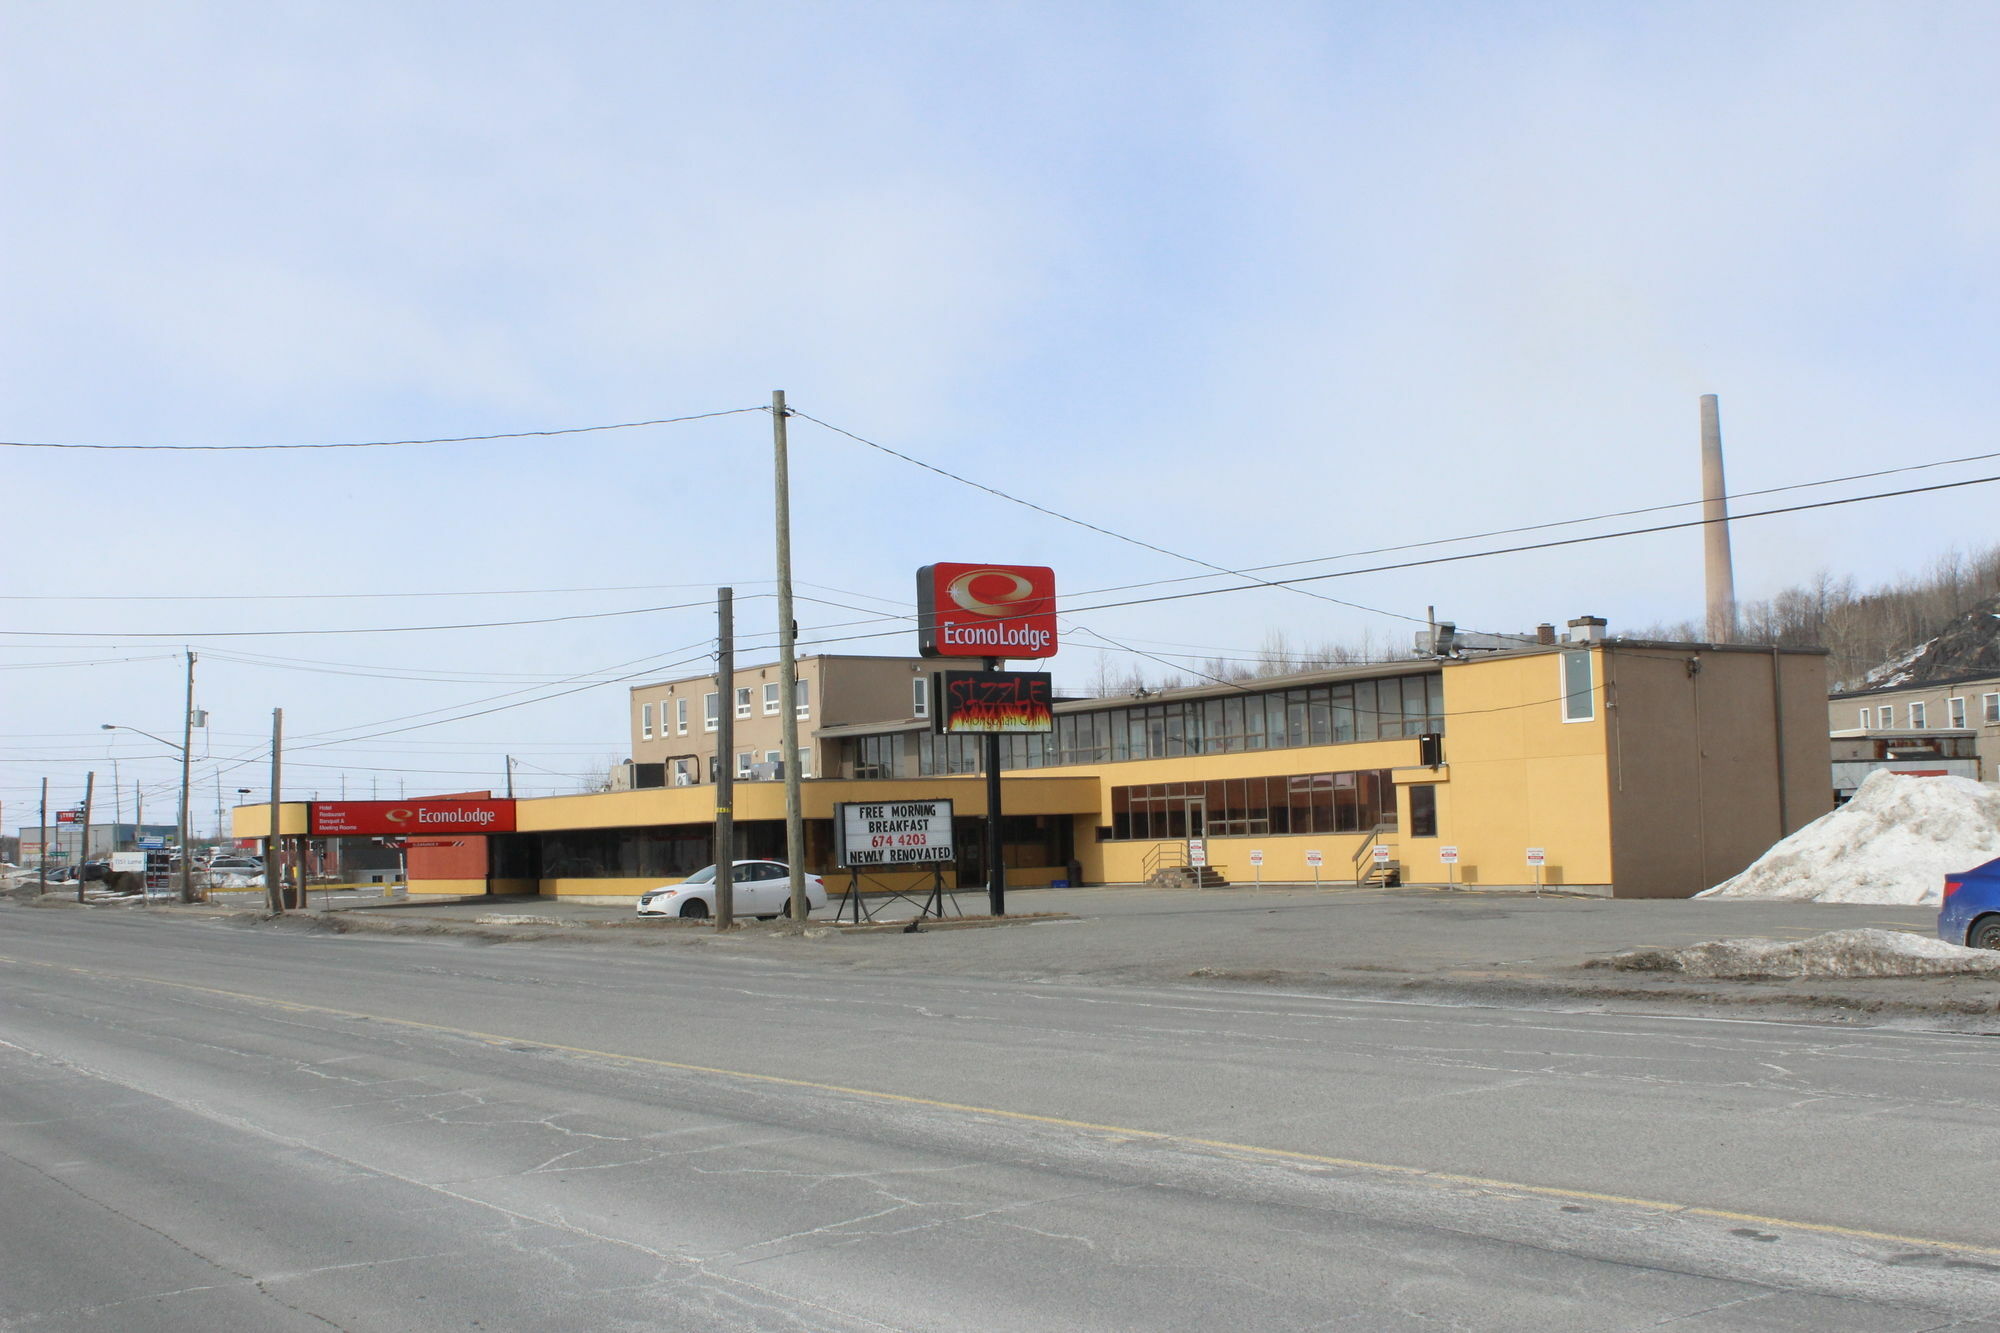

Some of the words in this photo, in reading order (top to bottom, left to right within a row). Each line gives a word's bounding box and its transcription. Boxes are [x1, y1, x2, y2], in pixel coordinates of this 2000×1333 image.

[944, 621, 1050, 651] EconoLodge
[418, 808, 495, 825] EconoLodge
[860, 807, 884, 819] FREE
[892, 805, 936, 818] MORNING
[869, 819, 929, 833] BREAKFAST
[871, 835, 893, 848] 674
[898, 834, 926, 846] 4203
[850, 850, 884, 863] NEWLY
[890, 847, 951, 861] RENOVATED
